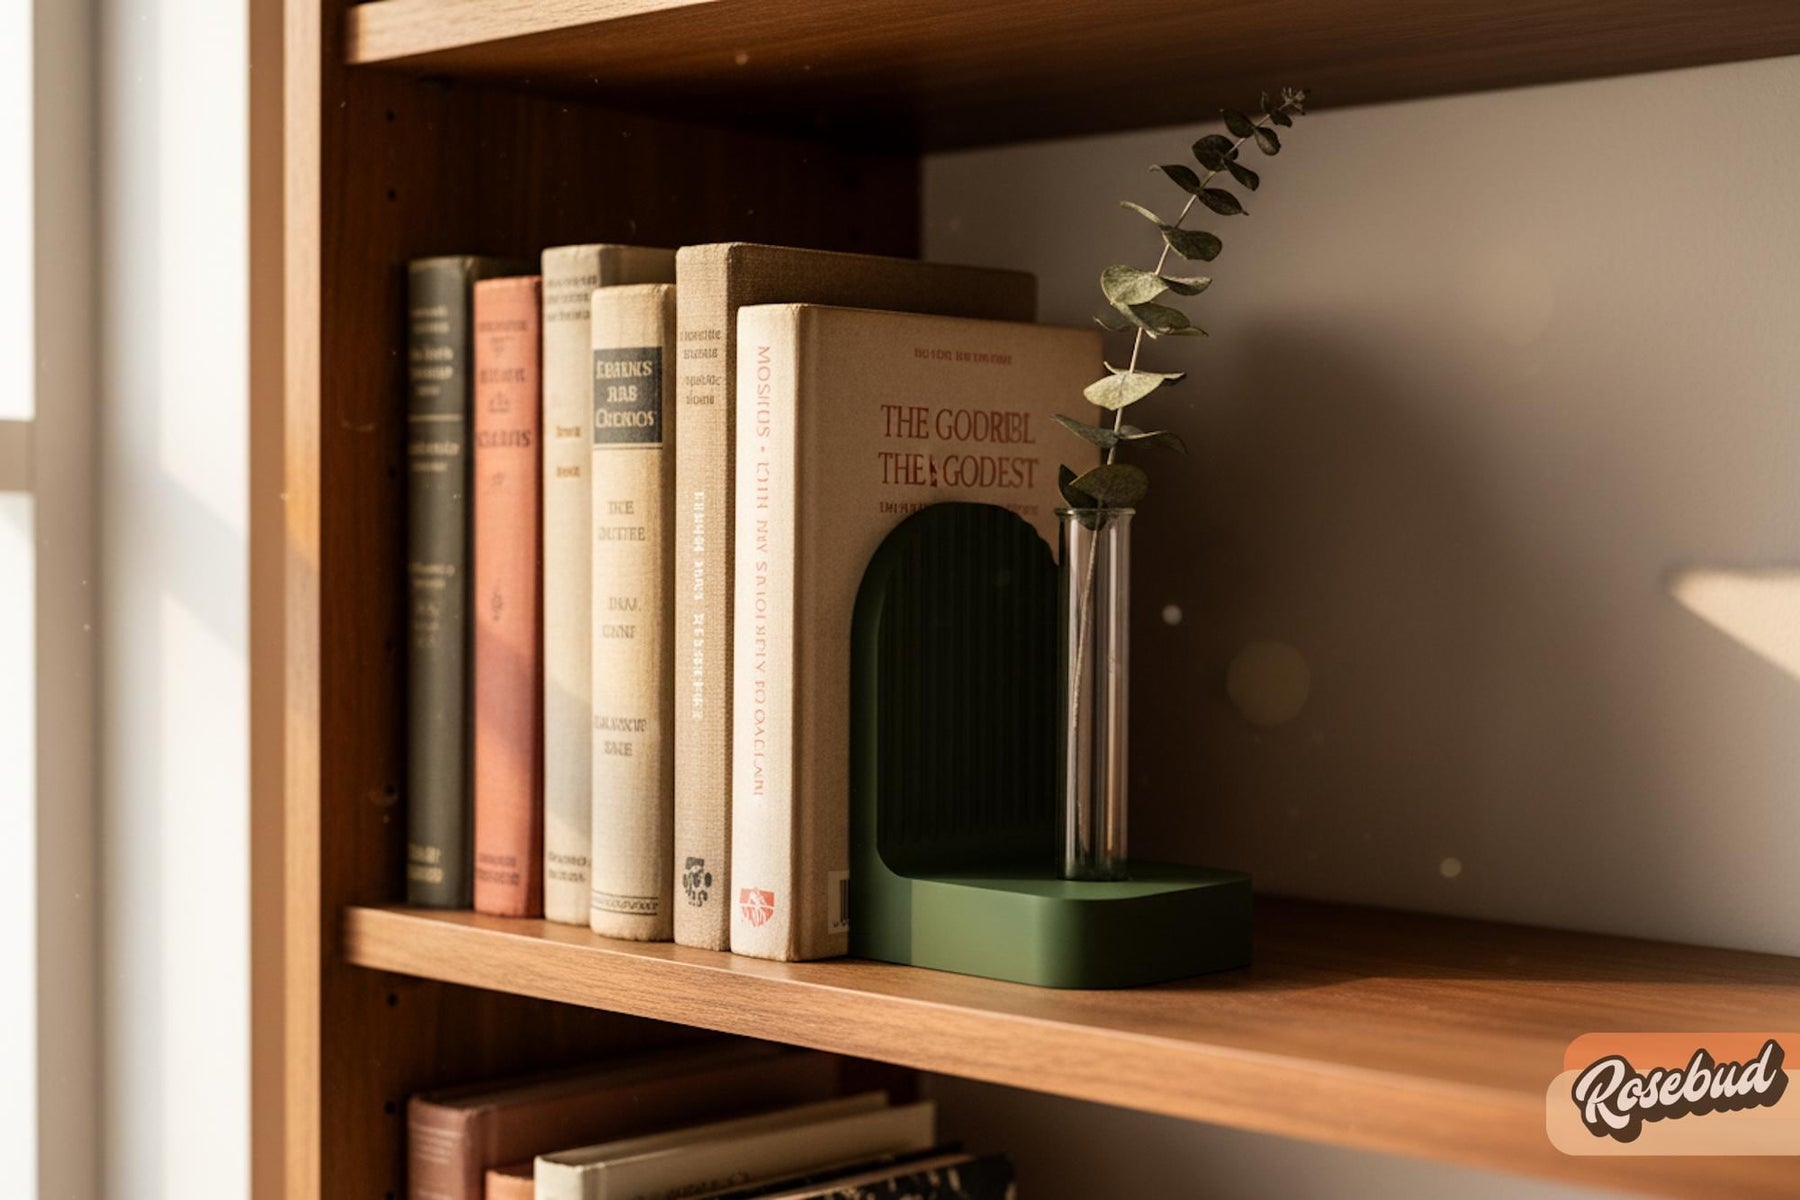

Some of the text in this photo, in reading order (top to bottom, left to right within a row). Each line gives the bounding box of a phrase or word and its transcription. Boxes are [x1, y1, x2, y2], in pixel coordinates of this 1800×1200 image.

[880, 404, 930, 440] THE
[877, 451, 1040, 489] THE GODEST
